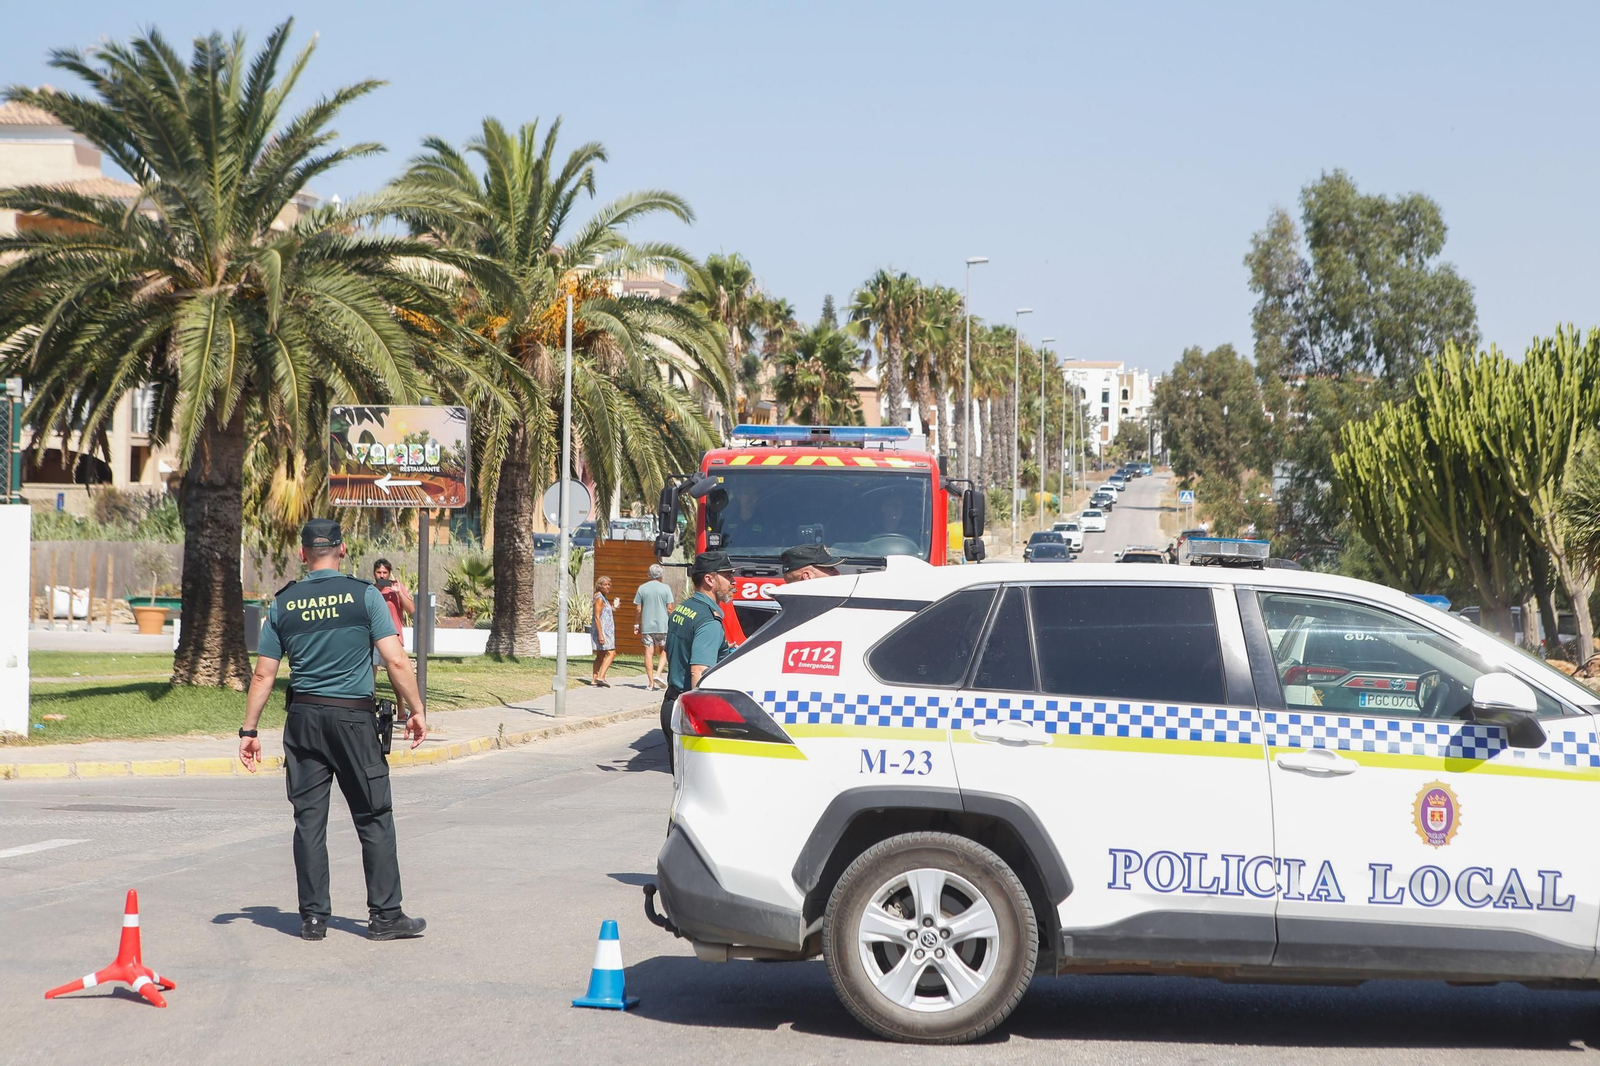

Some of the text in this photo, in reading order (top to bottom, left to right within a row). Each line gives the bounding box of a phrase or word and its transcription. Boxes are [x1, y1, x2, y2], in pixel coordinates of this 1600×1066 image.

[400, 465, 440, 473] RESTAURANTE
[286, 592, 355, 612] GUARDIA
[301, 606, 340, 622] CIVIL
[672, 613, 685, 626] CIVIL
[799, 646, 836, 662] 112
[1366, 693, 1390, 706] PGC
[859, 748, 934, 776] M-23
[1107, 848, 1576, 913] POLICIA LOCAL
